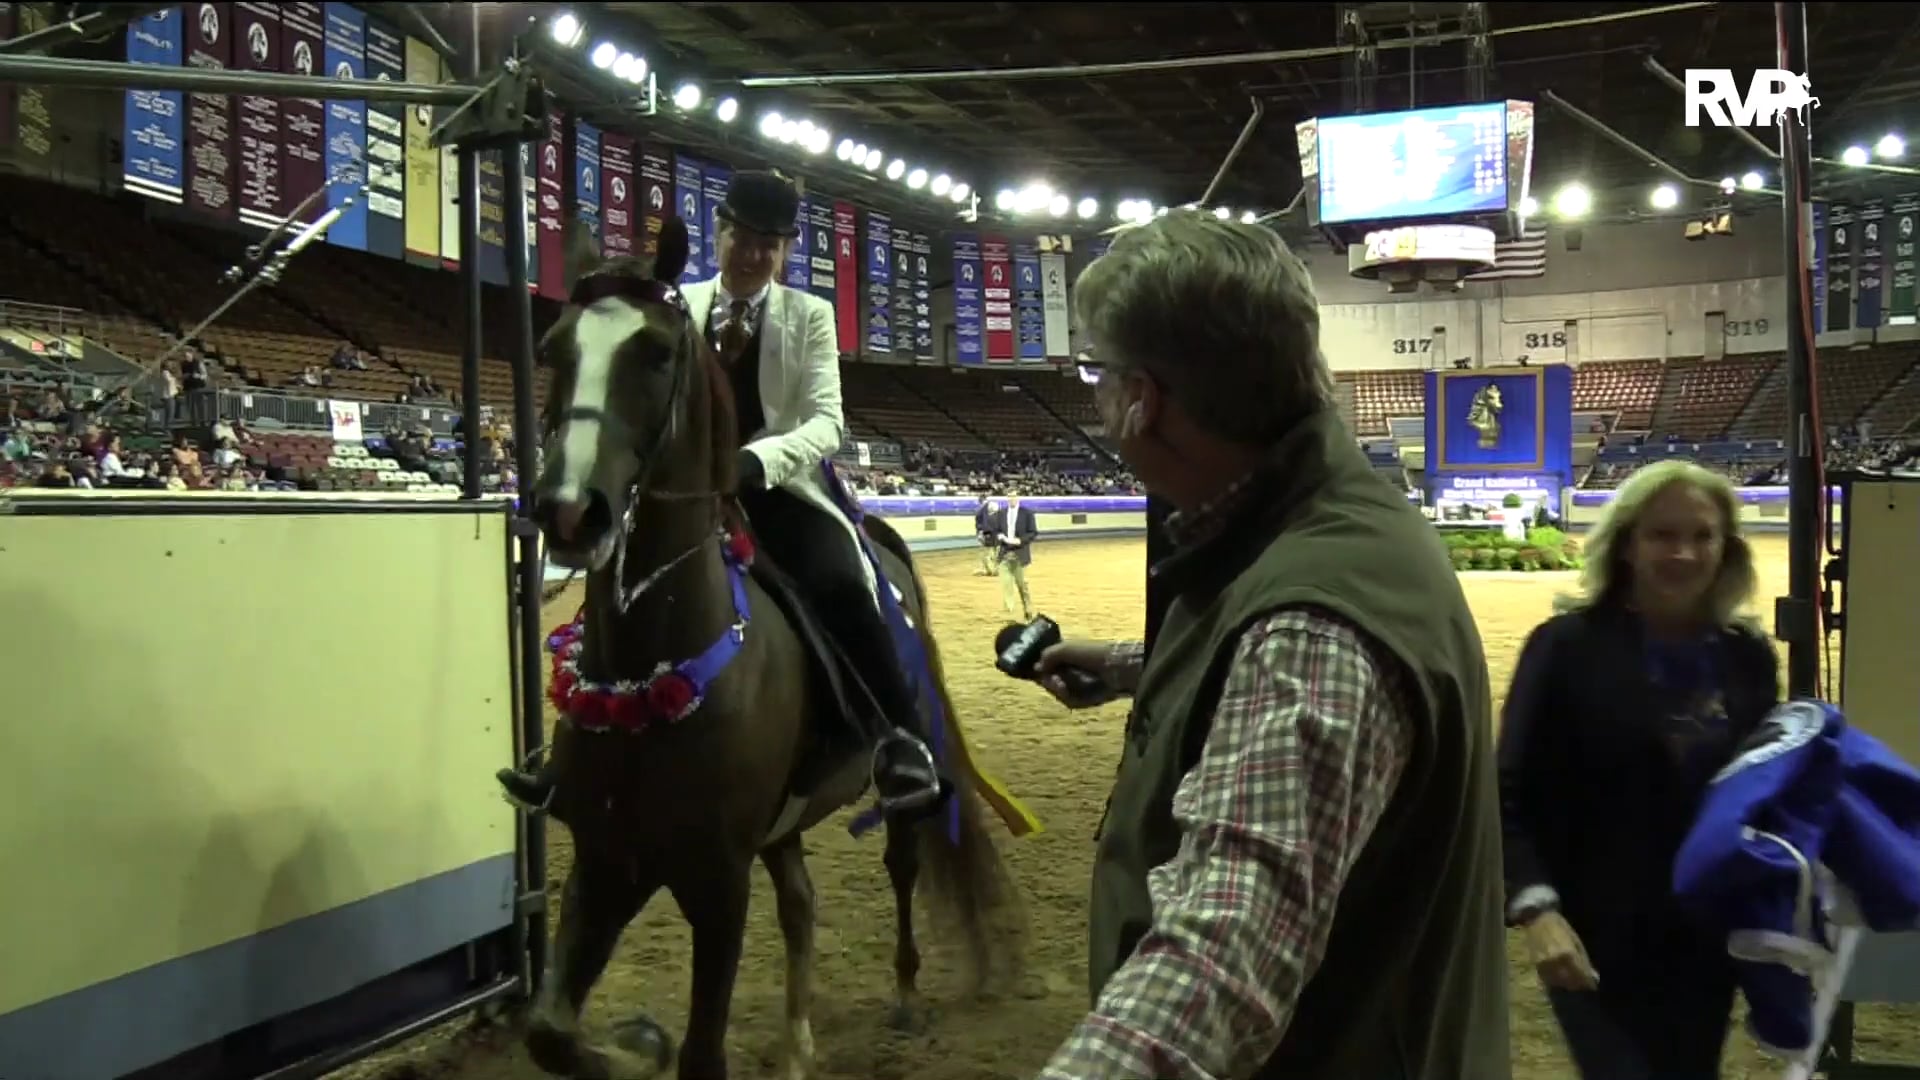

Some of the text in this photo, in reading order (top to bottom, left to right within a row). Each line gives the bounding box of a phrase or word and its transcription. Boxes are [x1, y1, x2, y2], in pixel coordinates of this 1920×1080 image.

[1726, 319, 1770, 337] 319
[1393, 338, 1433, 354] 317
[1525, 331, 1568, 349] 318
